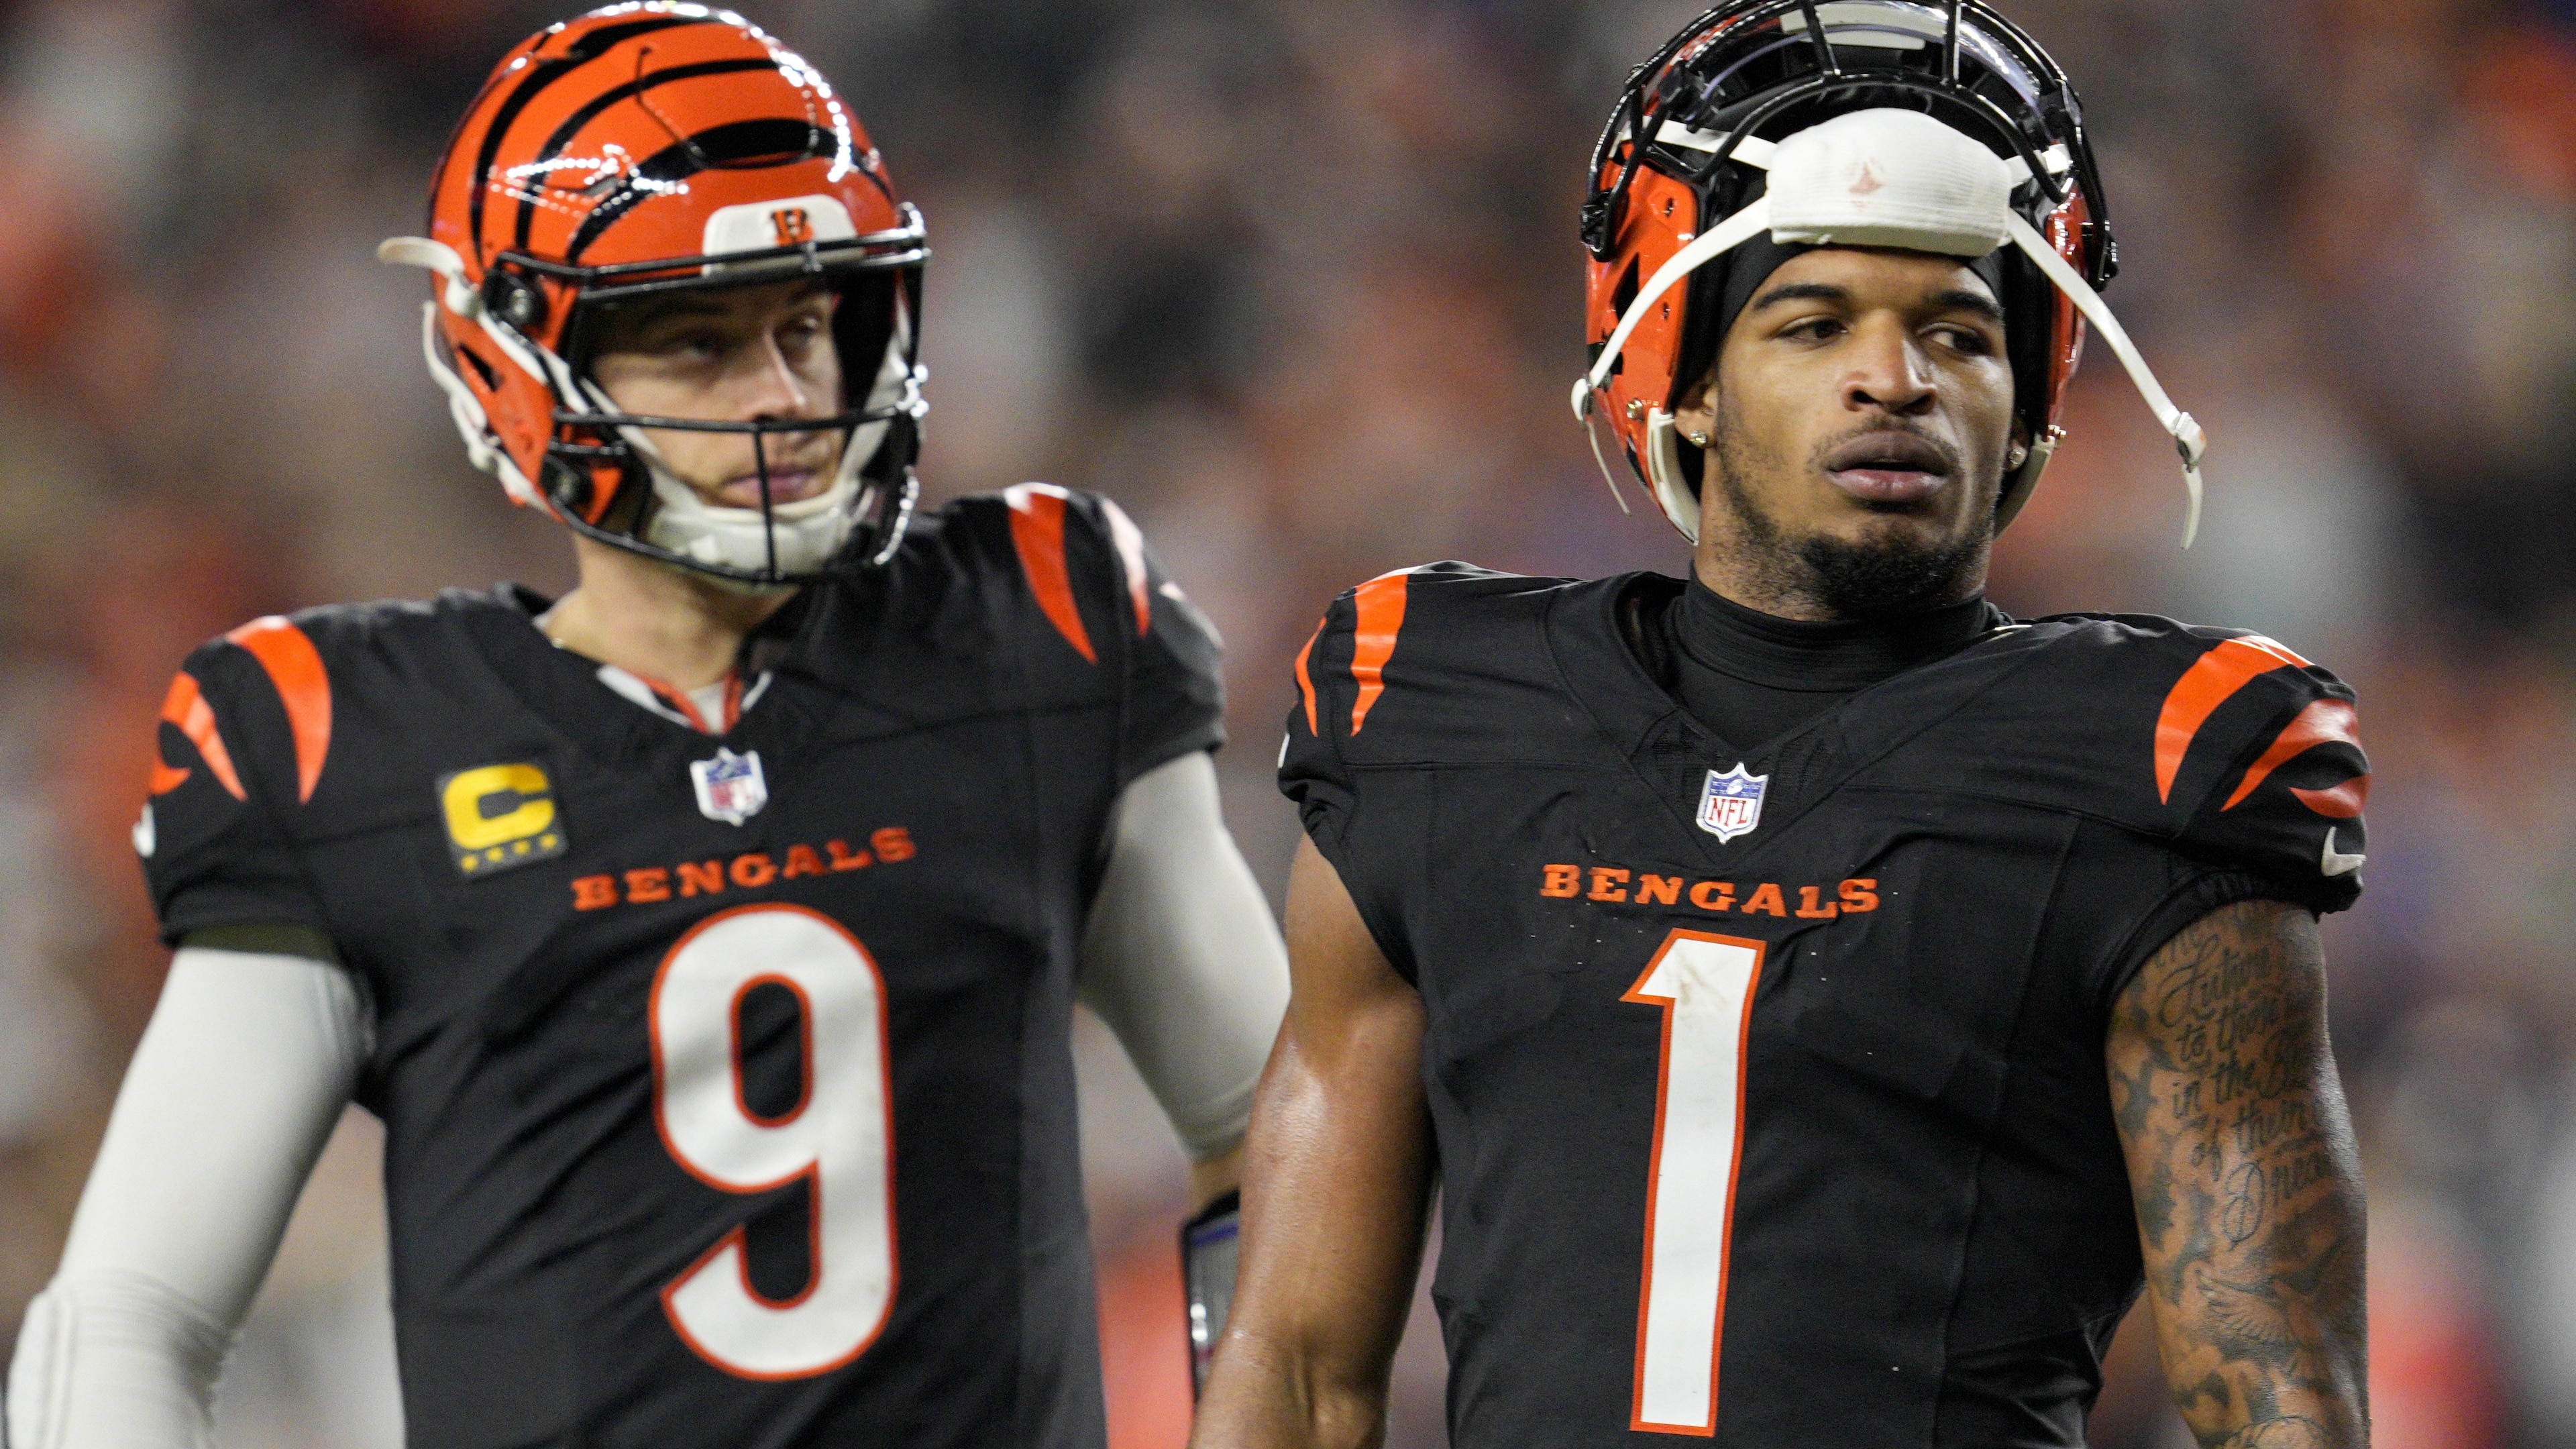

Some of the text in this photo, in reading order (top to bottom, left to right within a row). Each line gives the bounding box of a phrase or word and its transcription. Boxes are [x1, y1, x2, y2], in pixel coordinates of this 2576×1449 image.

[443, 763, 556, 850] C
[1708, 797, 1748, 827] NFL
[572, 827, 917, 912] BENGALS
[1540, 863, 1880, 919] BENGALS
[647, 902, 900, 1381] 9
[2172, 1080, 2201, 1119] in
[1619, 927, 1768, 1438] 1
